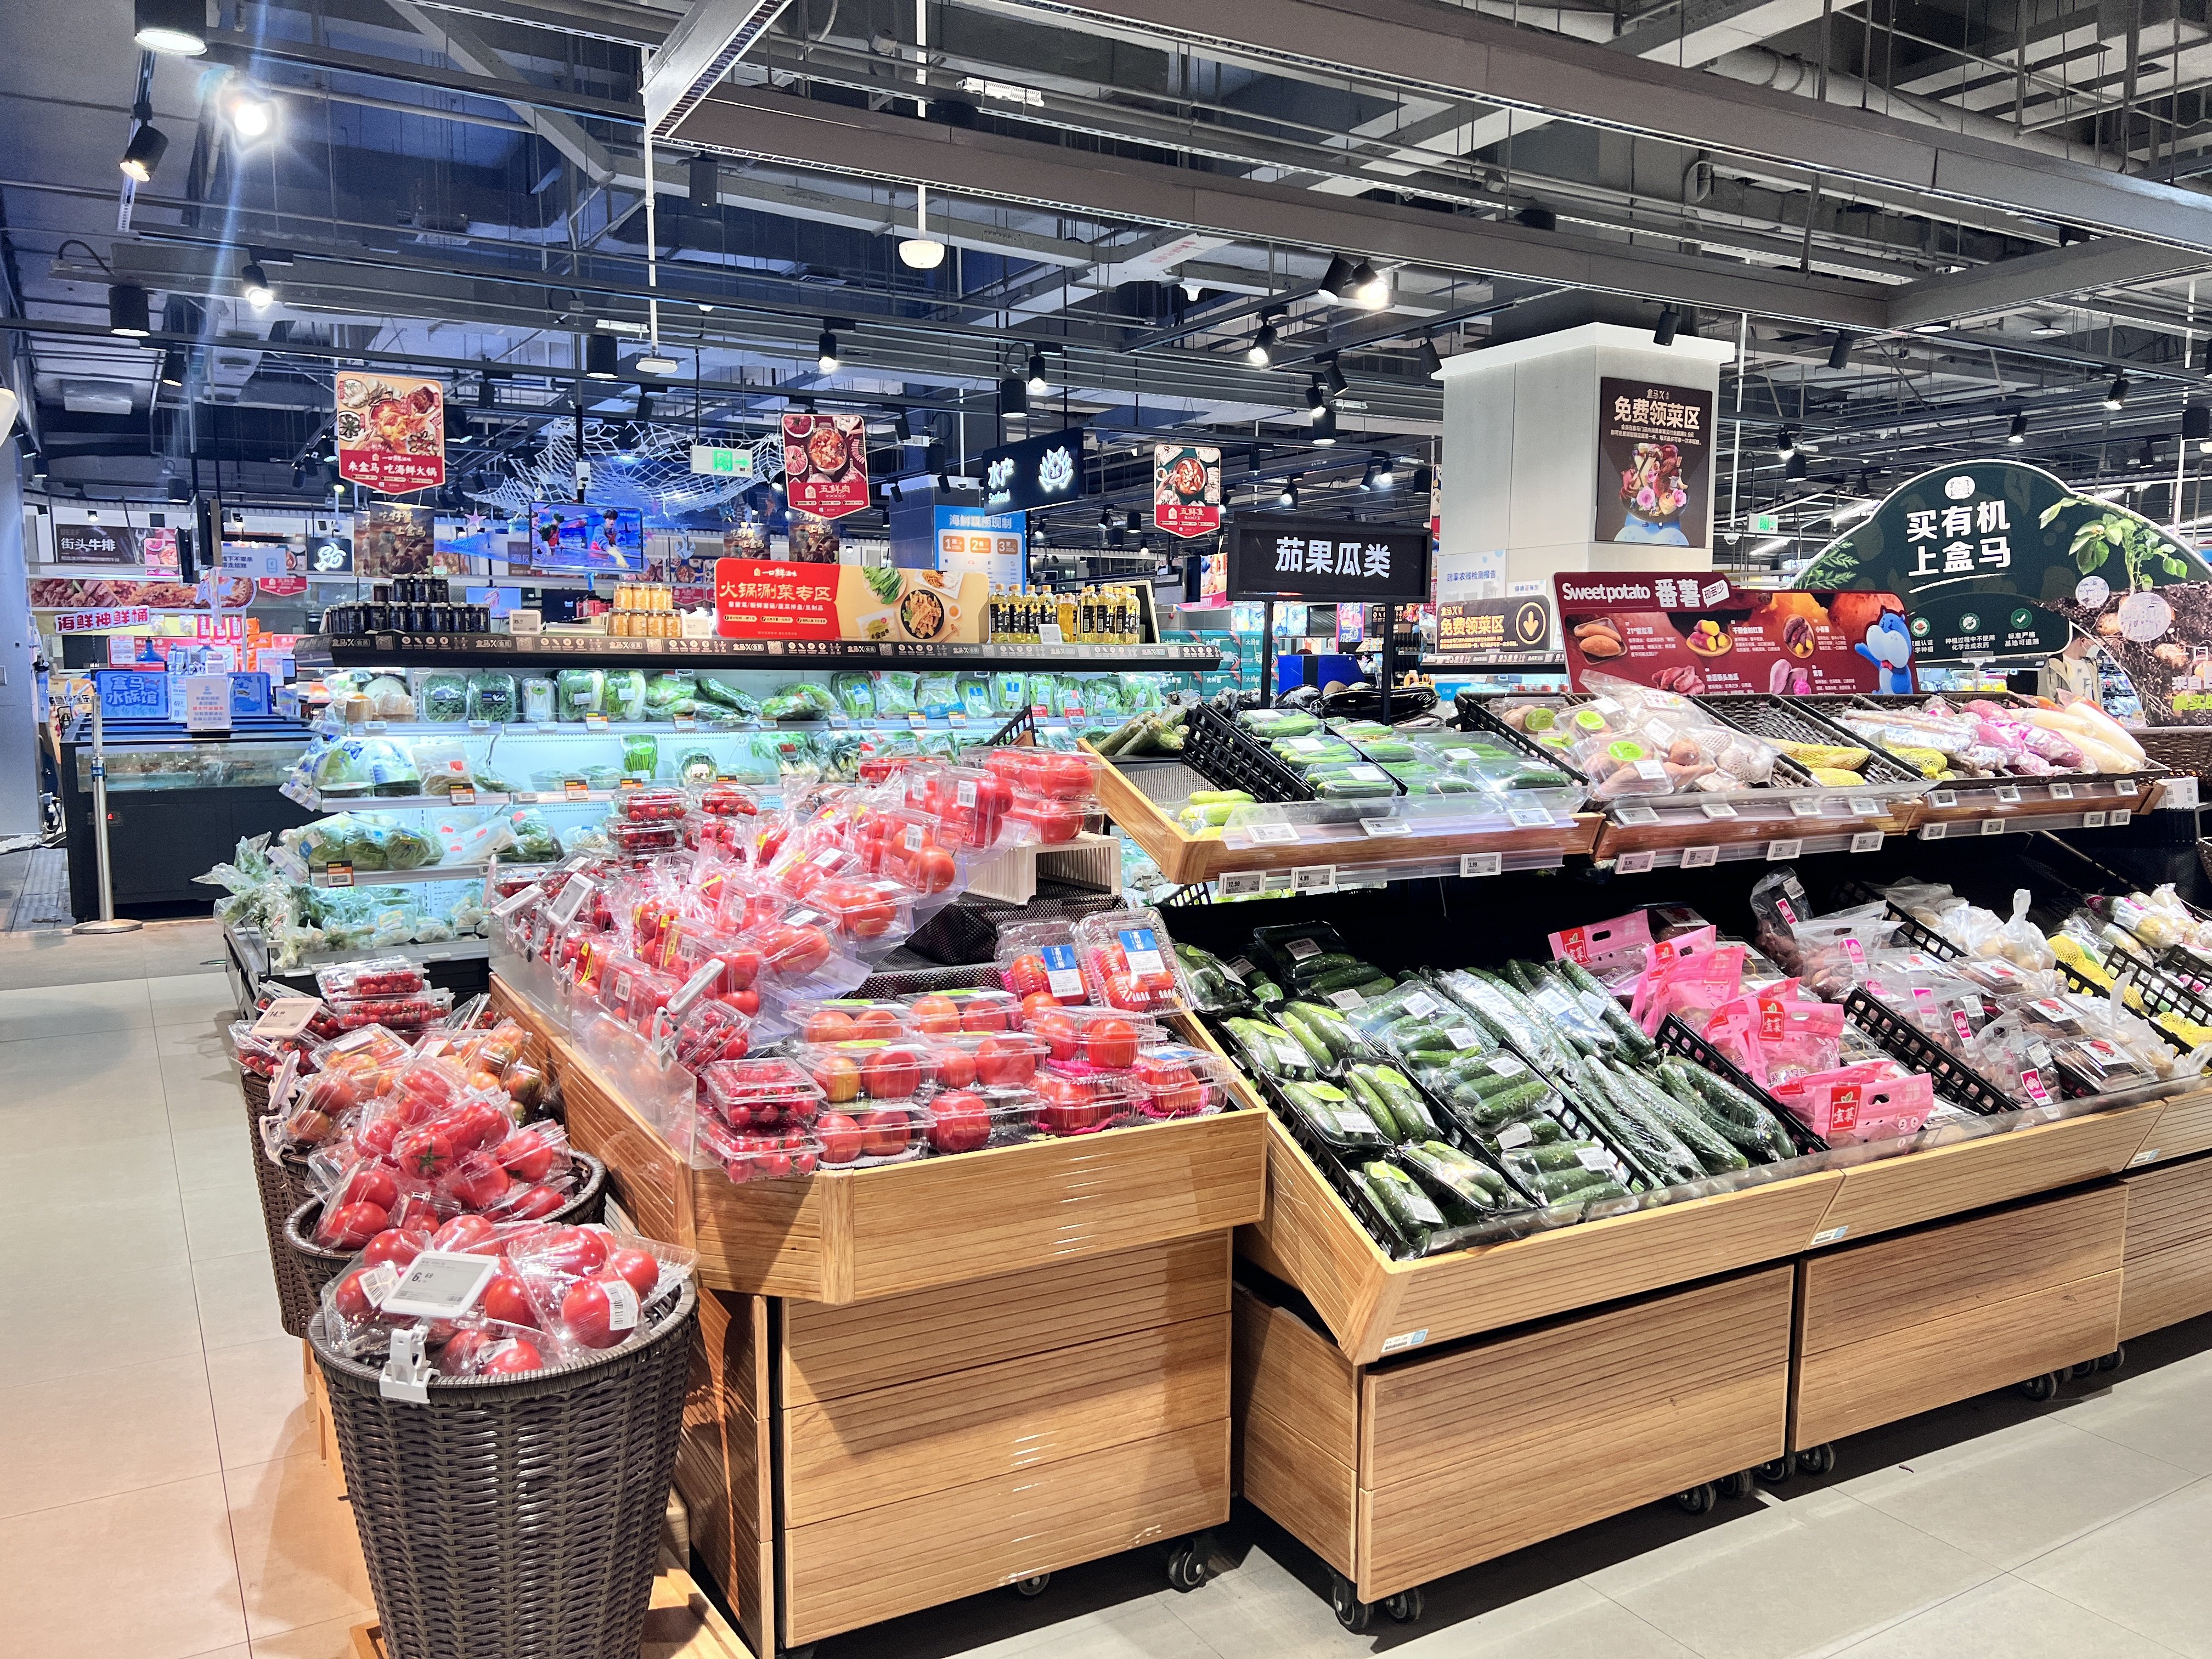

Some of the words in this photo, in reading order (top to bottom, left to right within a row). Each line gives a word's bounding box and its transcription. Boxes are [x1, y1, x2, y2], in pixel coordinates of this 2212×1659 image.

[1613, 396, 1701, 430] 免费领菜区
[348, 460, 380, 473] 来盒马
[384, 463, 437, 477] 吃海鲜火锅
[988, 457, 1014, 489] 水产
[819, 484, 850, 494] 五鲜肉
[988, 489, 1011, 504] Seafood
[1179, 507, 1205, 516] 五鲜鱼
[1906, 500, 2011, 543] 买有机
[60, 538, 116, 552] 街头牛排
[1275, 536, 1391, 578] 茄果瓜类
[1908, 536, 2011, 577] 上盒马
[1447, 569, 1496, 582] 蔬果农残检测报告
[719, 581, 833, 602] 火锅涮菜专区
[1655, 578, 1701, 608] 番薯
[1703, 582, 1724, 599] 知多少
[1440, 614, 1504, 636] 免费领菜区
[1945, 634, 1995, 645] 种植过程中不使用
[2005, 638, 2039, 647] 基地可追溯
[2008, 631, 2035, 640] 标准严格
[1952, 642, 1989, 651] 化学合成农药
[111, 675, 144, 691] 盒马
[107, 691, 159, 706] 水族馆
